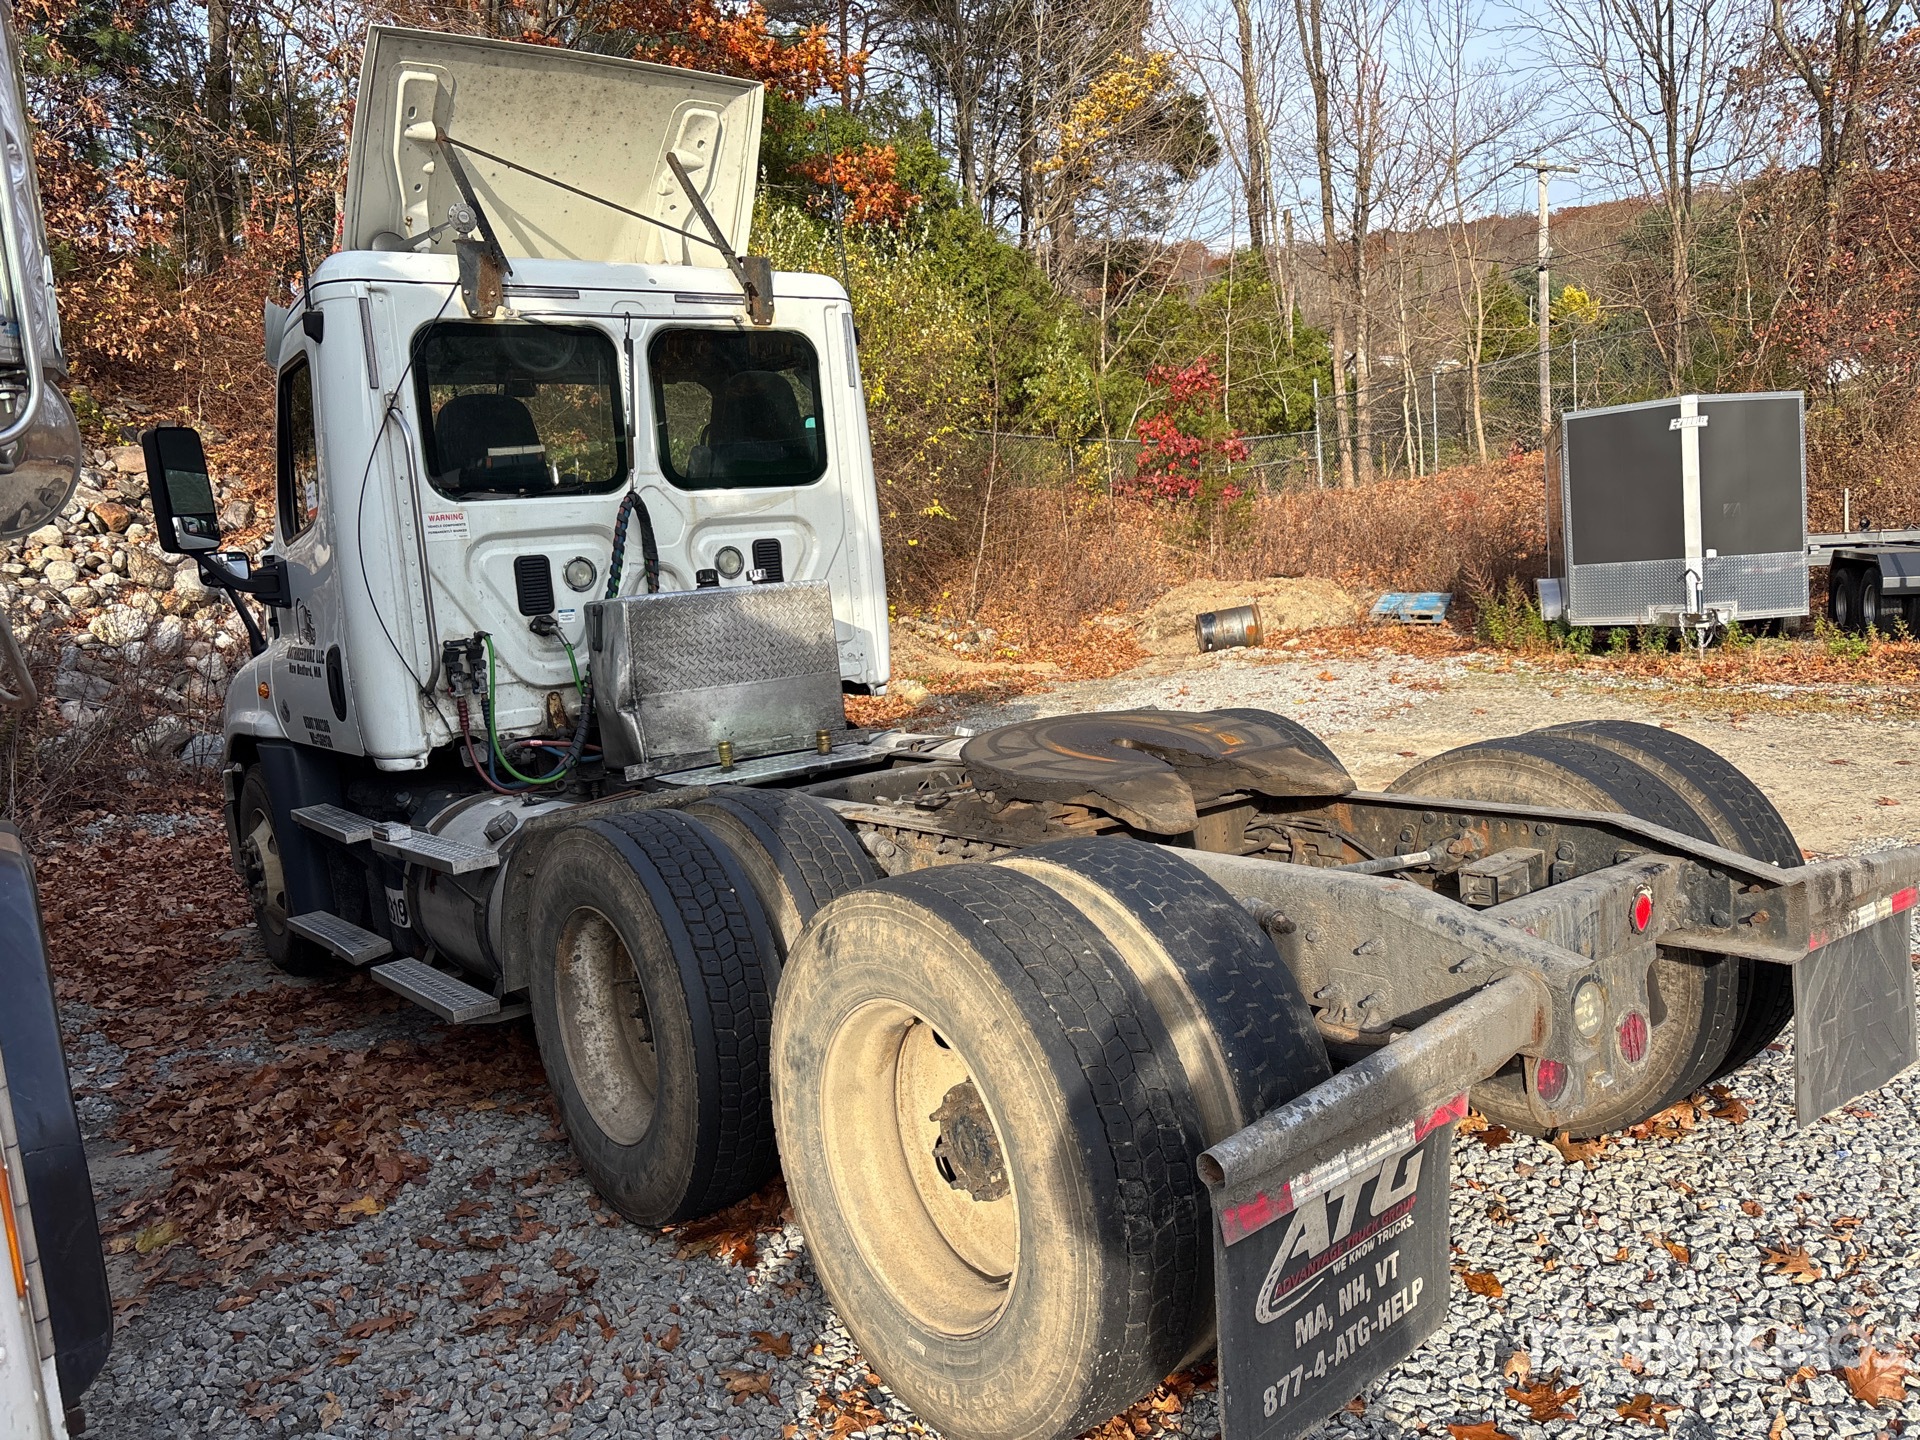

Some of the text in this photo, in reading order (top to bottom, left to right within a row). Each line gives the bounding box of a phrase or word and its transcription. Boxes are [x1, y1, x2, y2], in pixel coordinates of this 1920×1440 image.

[428, 513, 463, 521] WARNING
[314, 667, 322, 678] MA
[316, 650, 325, 664] LLC
[1290, 1148, 1425, 1260] ATG
[1275, 1196, 1417, 1295] ADVANTAGE TRUCK GROUP
[1332, 1214, 1415, 1276] WE KNOW TRUCKS.
[1295, 1249, 1400, 1350] MA, NH, VT
[1262, 1276, 1425, 1418] 877-4-ATG-HELP
